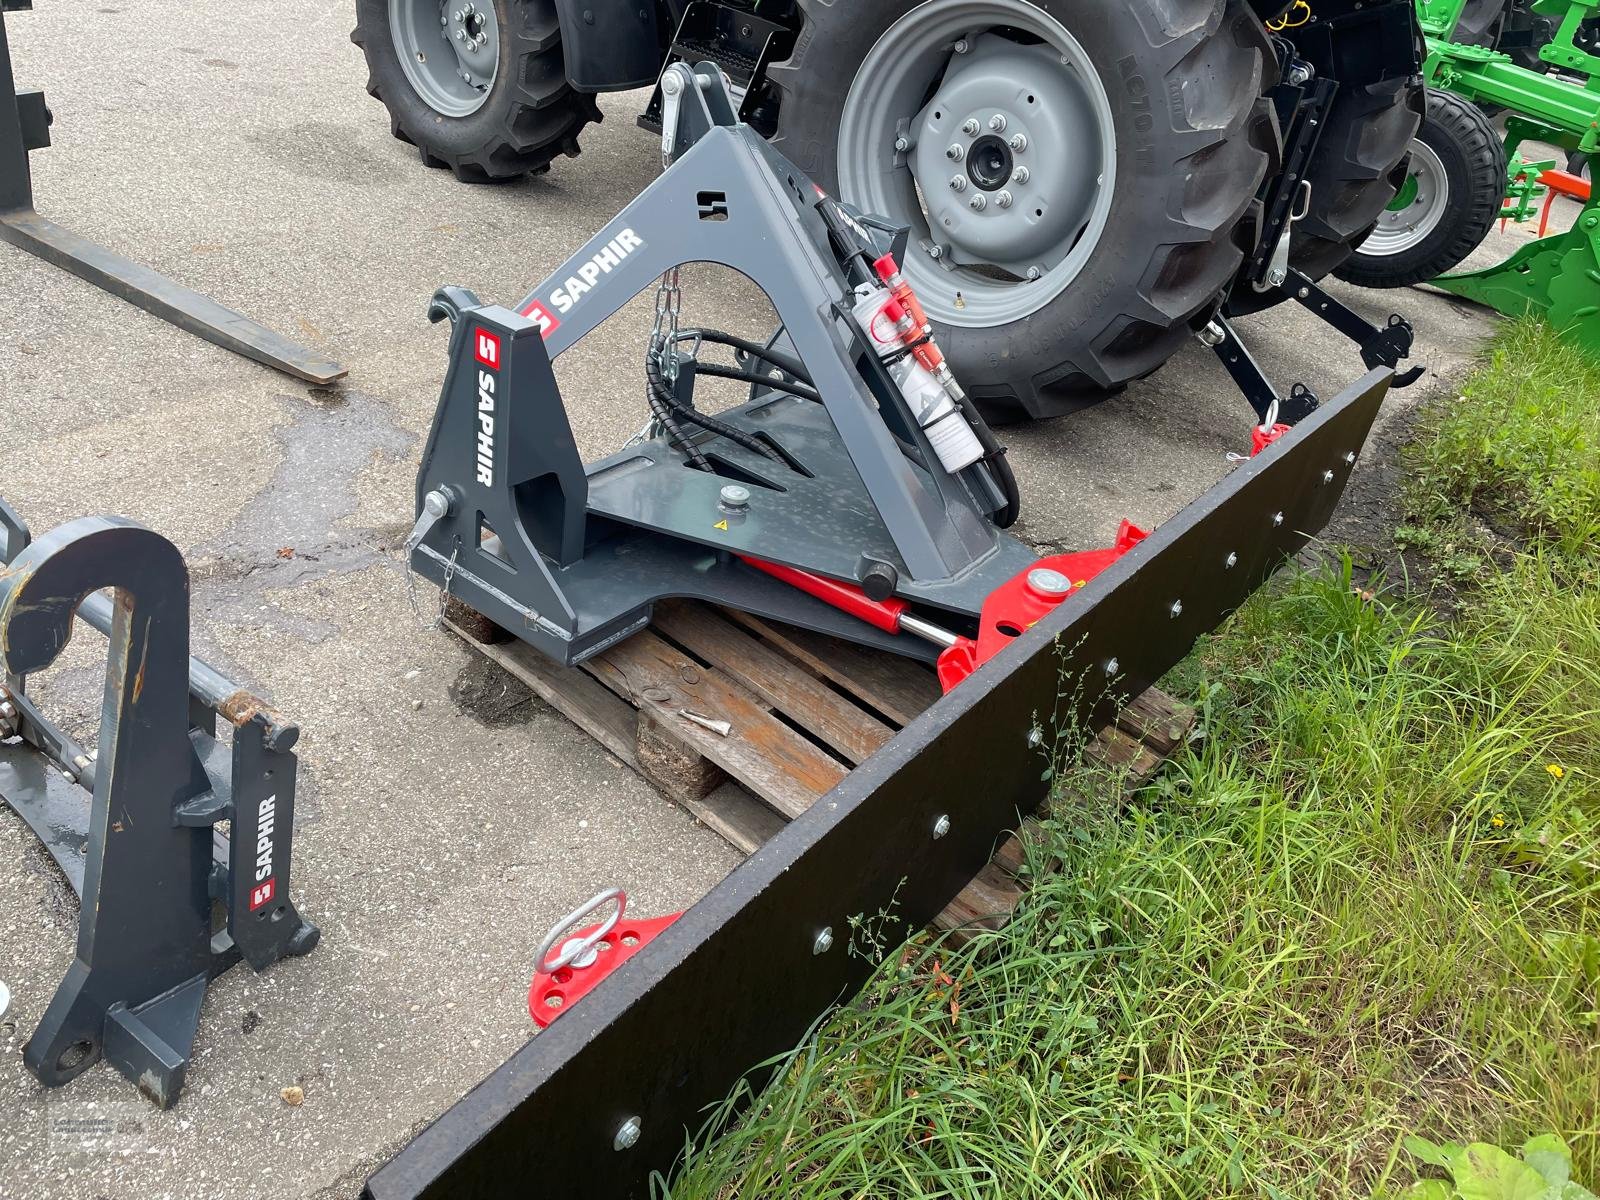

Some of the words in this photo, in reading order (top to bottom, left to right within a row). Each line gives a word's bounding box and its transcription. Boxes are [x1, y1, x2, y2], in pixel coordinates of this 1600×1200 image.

[549, 228, 644, 314] SAPHIR
[476, 369, 495, 488] SAPHIR
[255, 794, 276, 881] SAPHIR
